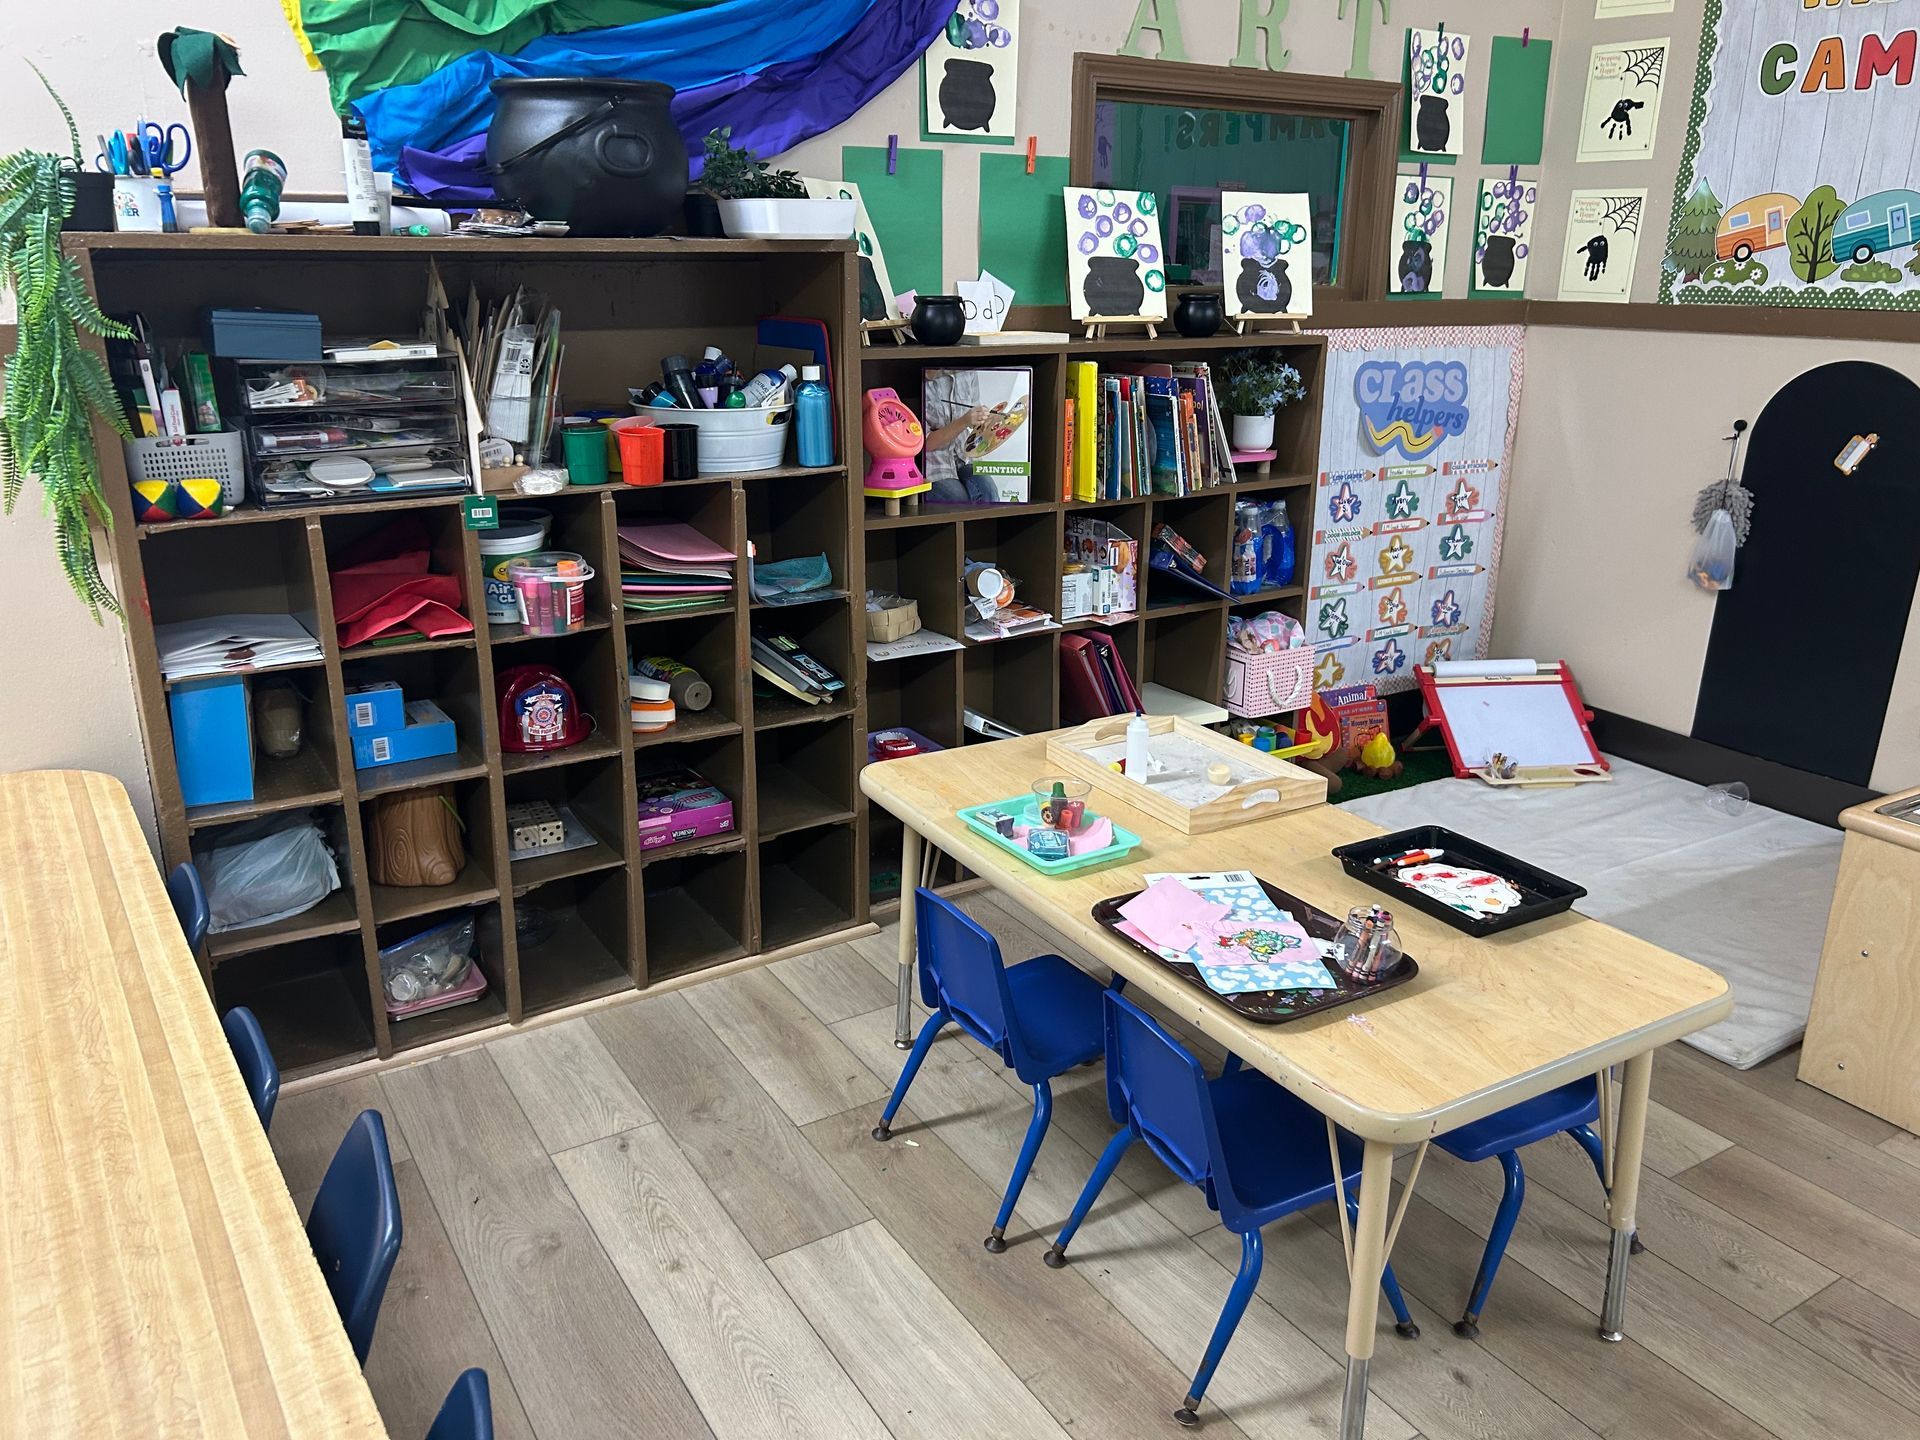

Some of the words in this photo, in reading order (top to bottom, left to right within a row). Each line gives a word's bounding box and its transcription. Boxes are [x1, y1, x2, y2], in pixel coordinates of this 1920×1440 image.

[1116, 0, 1390, 79] ART
[1760, 29, 1918, 96] CAM
[1386, 391, 1464, 438] helpers
[975, 465, 1024, 474] PAINTING
[499, 594, 516, 604] CL
[1337, 690, 1368, 706] Animal
